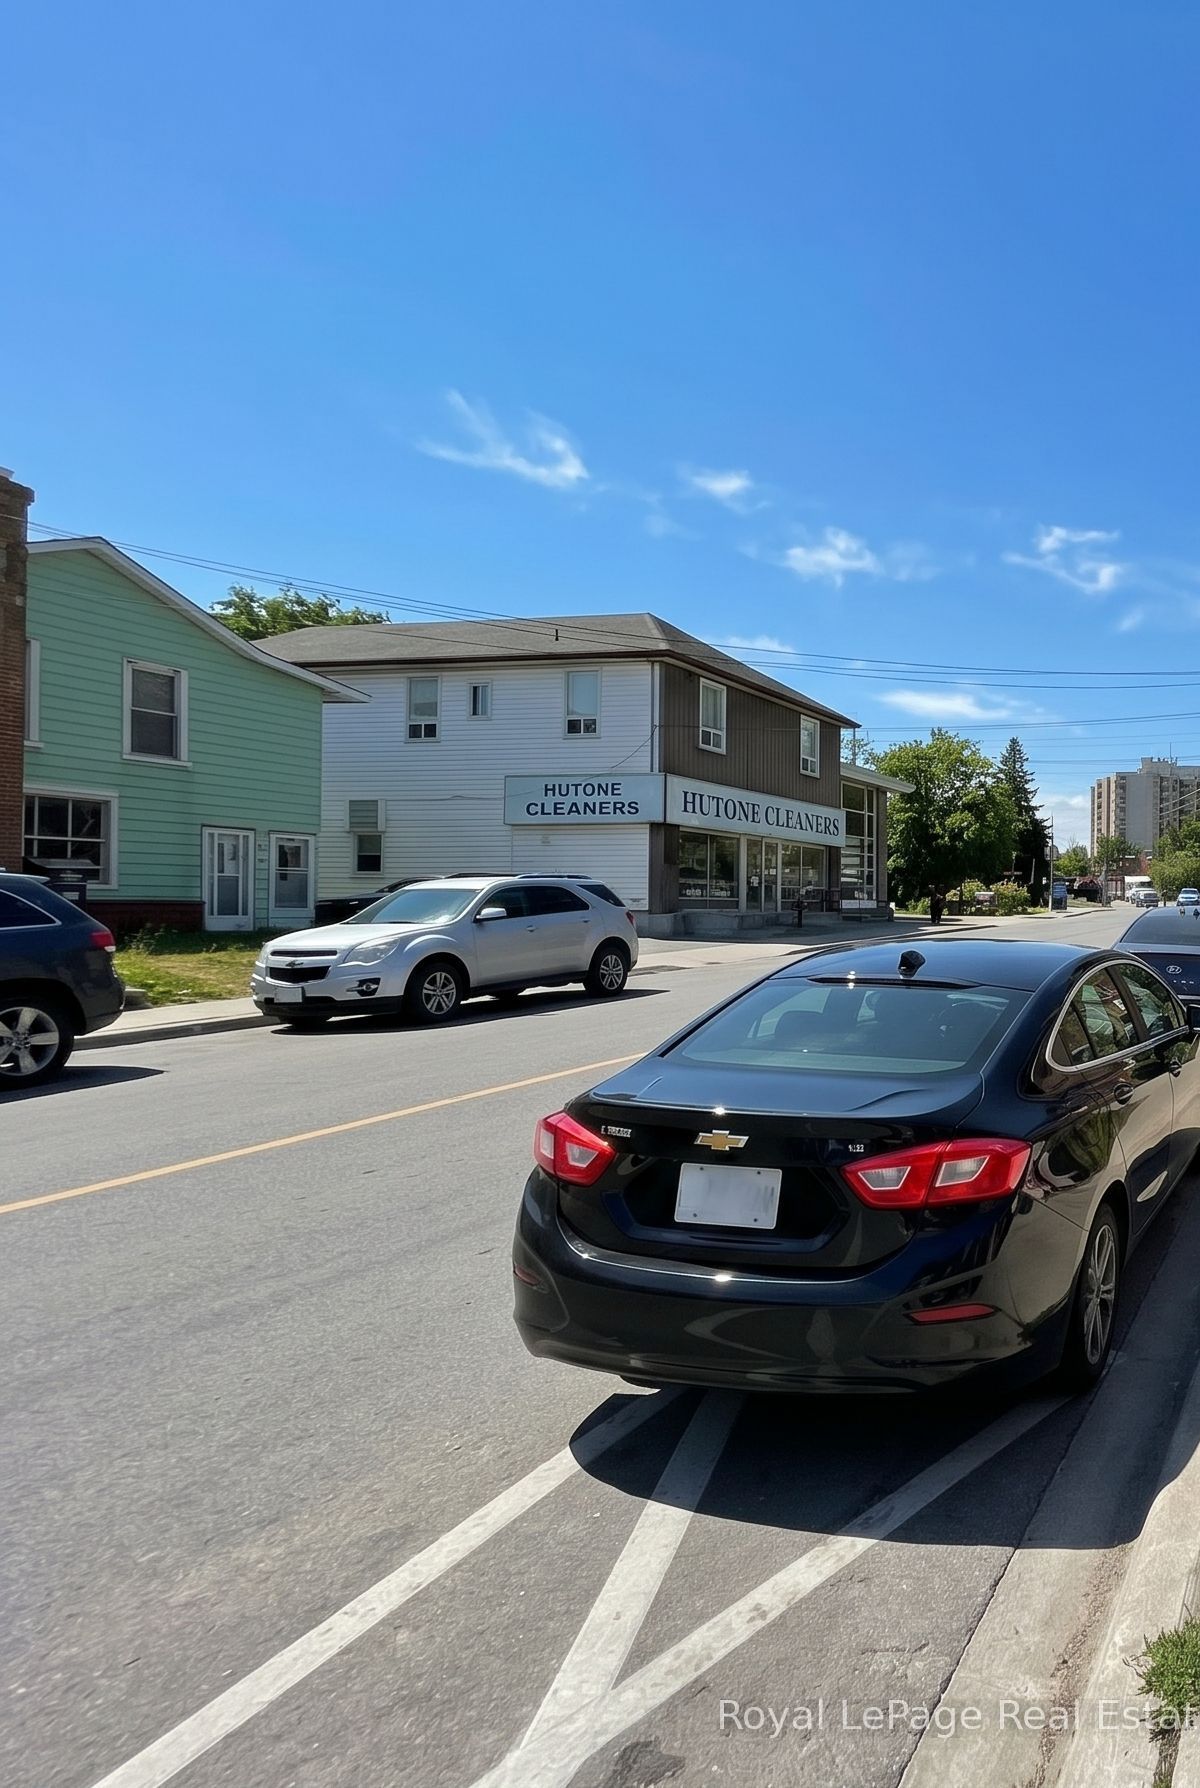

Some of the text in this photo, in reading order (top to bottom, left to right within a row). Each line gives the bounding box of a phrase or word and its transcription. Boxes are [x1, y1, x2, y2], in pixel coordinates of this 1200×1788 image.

[543, 782, 622, 797] HUTONE
[525, 801, 640, 816] CLEANERS
[681, 790, 840, 837] HUTONE CLEANERS
